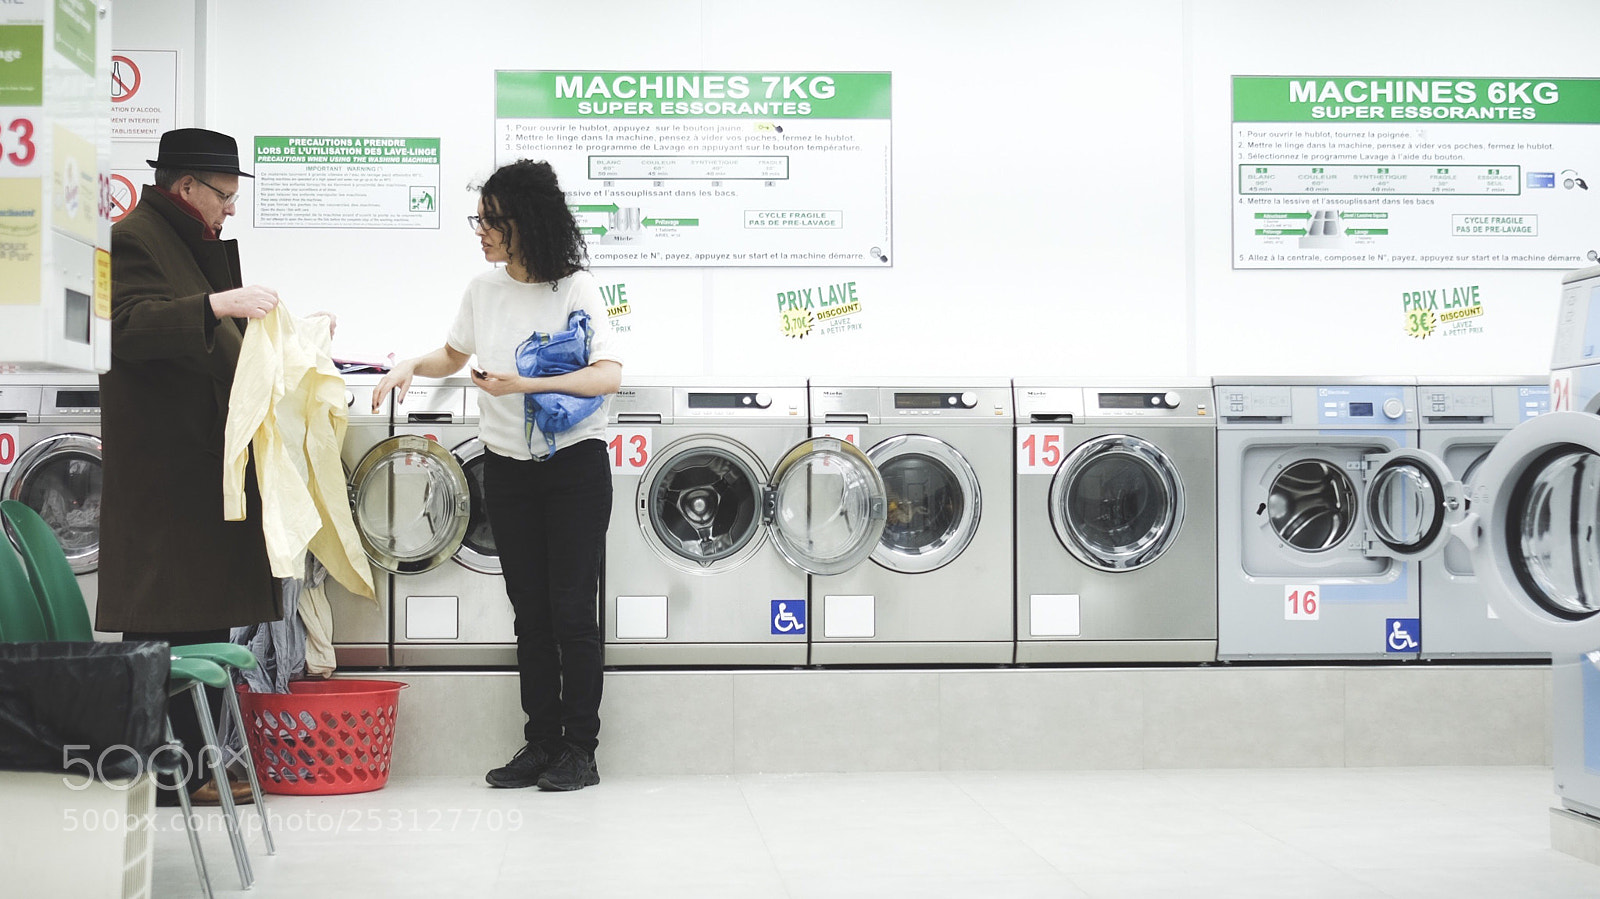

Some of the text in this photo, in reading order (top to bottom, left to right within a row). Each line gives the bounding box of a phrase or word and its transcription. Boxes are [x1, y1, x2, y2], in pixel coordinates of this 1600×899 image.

[556, 76, 836, 99] MACHINES 7KG
[1289, 80, 1559, 104] MACHINES 6KG
[578, 102, 812, 115] SUPER ESSORANTES
[1311, 106, 1536, 119] SUPER ESSORANTES
[0, 118, 35, 166] 3
[1377, 131, 1411, 139] poignée.
[1321, 197, 1379, 205] l'assouplissant
[776, 281, 858, 312] PRIX LAVE
[1402, 286, 1480, 312] PRIX LAVE
[817, 303, 860, 320] DISCOUNT
[830, 318, 851, 326] LAVEZ
[1409, 312, 1429, 332] 3€
[1440, 307, 1481, 322] DISCOUNT
[827, 323, 862, 334] PETIT PRIX
[1554, 378, 1569, 411] 21
[608, 434, 648, 468] 13
[1022, 434, 1060, 467] 15
[1288, 590, 1316, 615] 16
